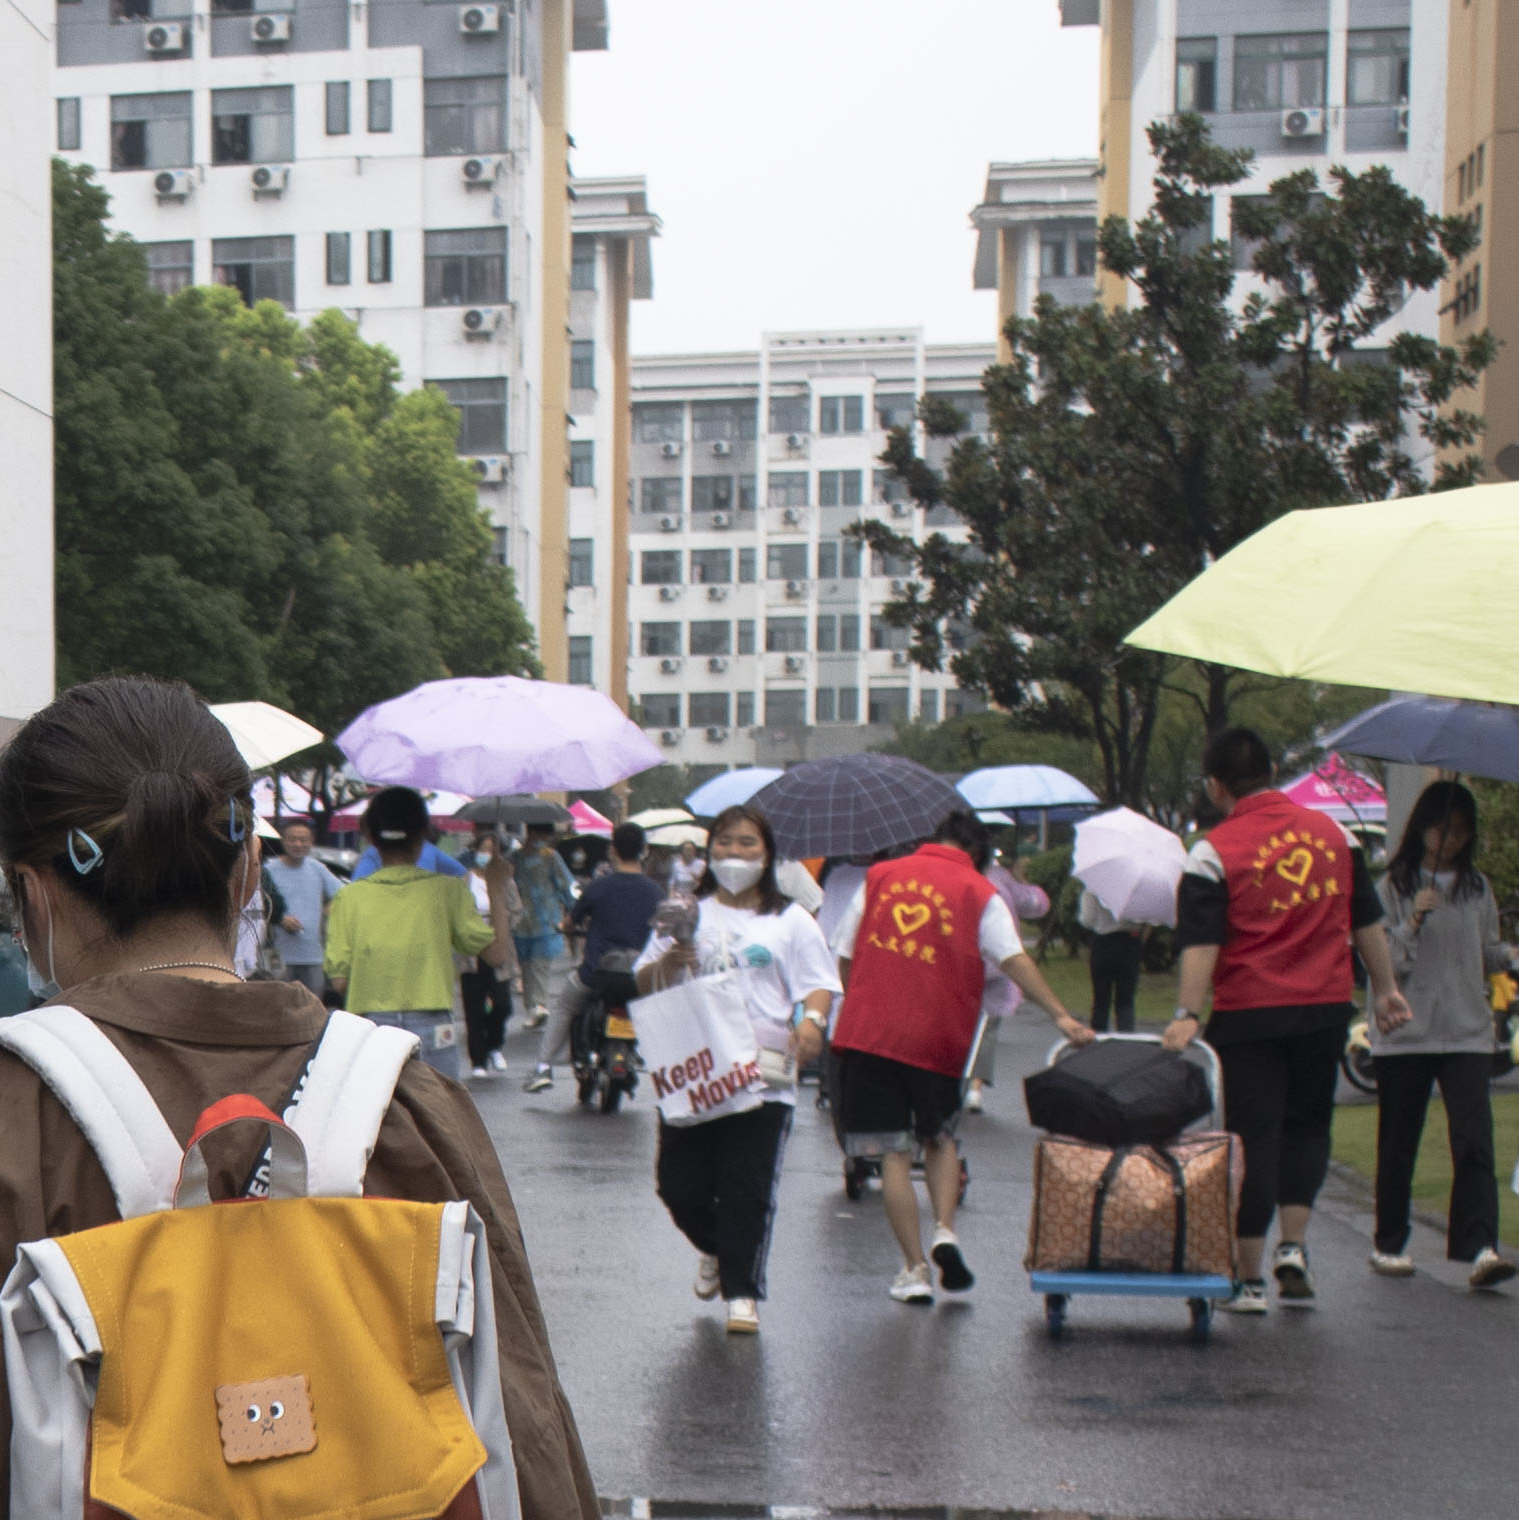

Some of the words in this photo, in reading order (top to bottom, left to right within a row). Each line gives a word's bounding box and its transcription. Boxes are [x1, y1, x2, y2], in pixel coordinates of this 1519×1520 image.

[866, 931, 938, 964] 人文学院
[651, 1047, 715, 1100] Keep
[687, 1060, 762, 1115] Movin
